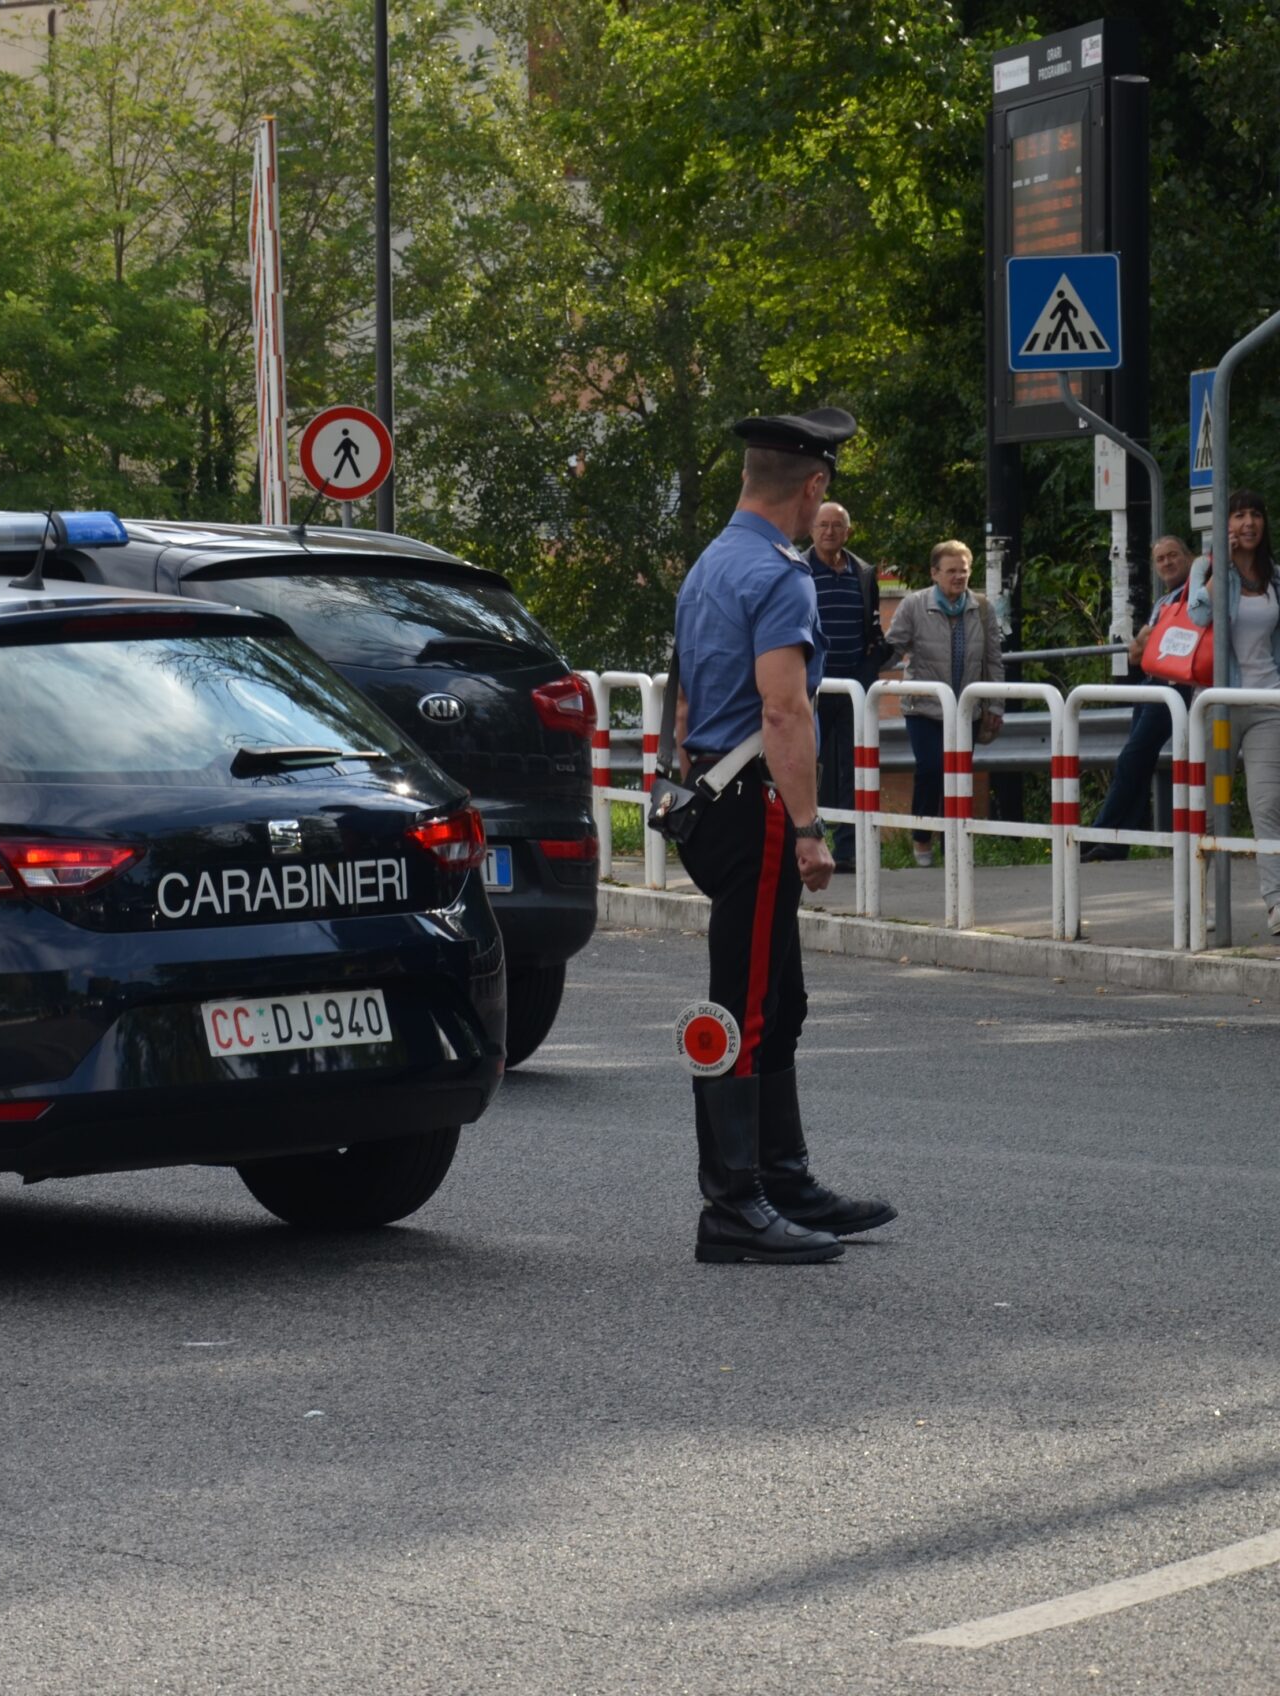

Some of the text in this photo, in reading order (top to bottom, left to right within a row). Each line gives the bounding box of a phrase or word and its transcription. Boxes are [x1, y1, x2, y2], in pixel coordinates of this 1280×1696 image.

[428, 700, 461, 717] KIA
[157, 857, 408, 919] CARABINIERI
[210, 996, 383, 1050] CC DJ 940
[676, 1007, 736, 1055] MINISTERO DELLA DIFESA
